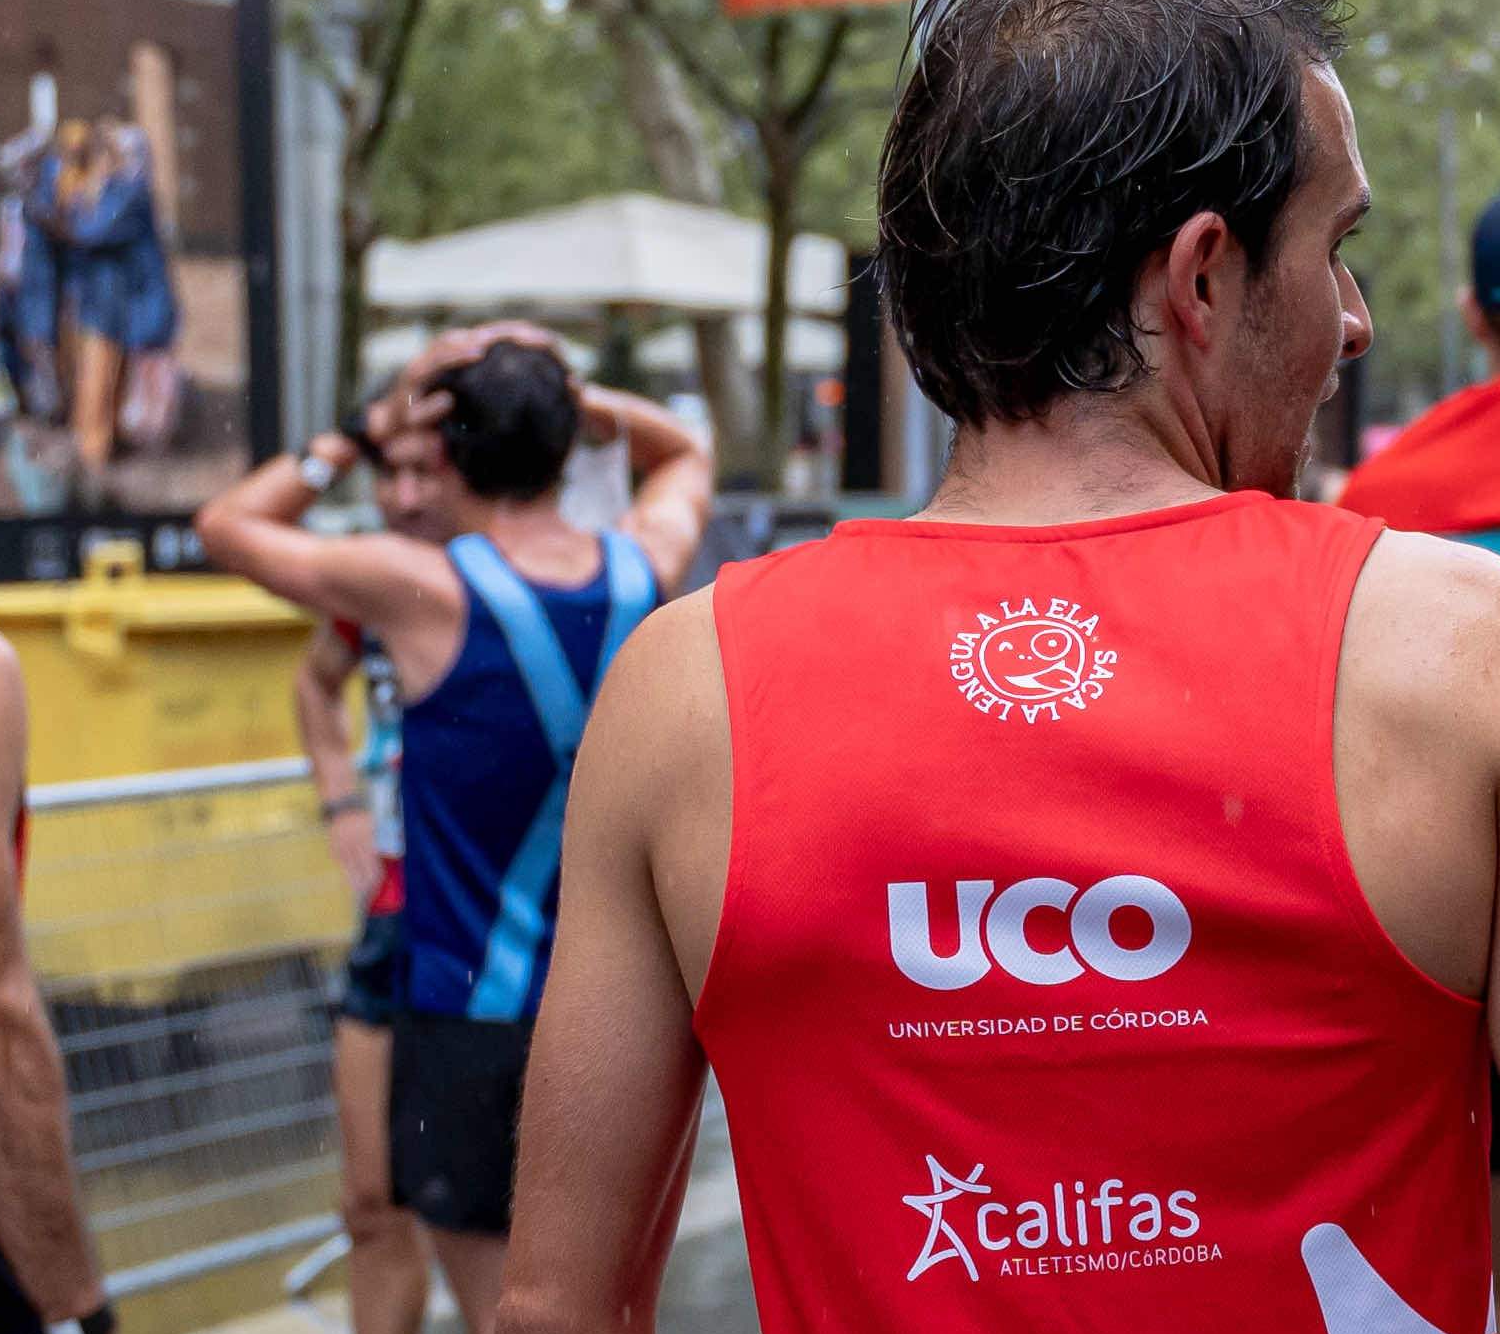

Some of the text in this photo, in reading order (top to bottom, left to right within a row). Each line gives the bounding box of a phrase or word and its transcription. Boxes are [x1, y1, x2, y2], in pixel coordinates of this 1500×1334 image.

[950, 597, 1117, 724] SACA LA LENGUA A LA ELA
[887, 874, 1192, 991] UCO
[888, 1007, 1208, 1038] UNIVERSIDAD DE CÓRDOBA
[977, 1178, 1200, 1251] califas
